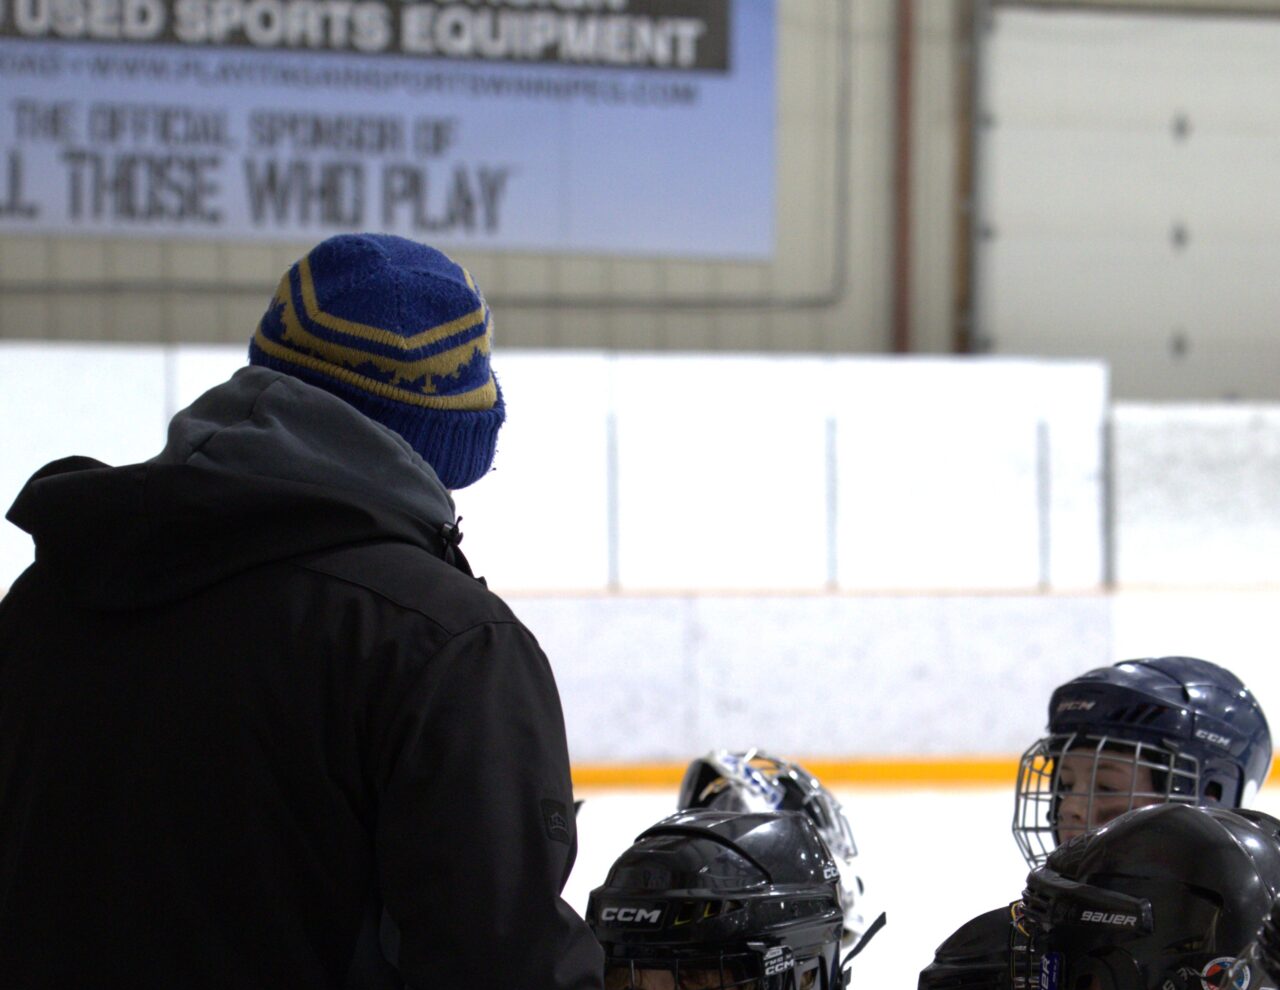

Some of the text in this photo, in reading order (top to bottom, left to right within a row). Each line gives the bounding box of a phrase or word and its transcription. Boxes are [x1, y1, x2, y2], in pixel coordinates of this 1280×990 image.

[13, 0, 705, 68] USED SPORTS EQUIPMENT
[14, 103, 456, 156] THE OFFICIAL SPONSOR OF
[62, 151, 223, 224] THOSE
[246, 155, 365, 228] WHO
[382, 163, 510, 234] PLAY
[1194, 729, 1232, 746] CCM
[601, 907, 662, 923] CCM
[1080, 910, 1137, 926] BAUER
[765, 959, 794, 976] CCM
